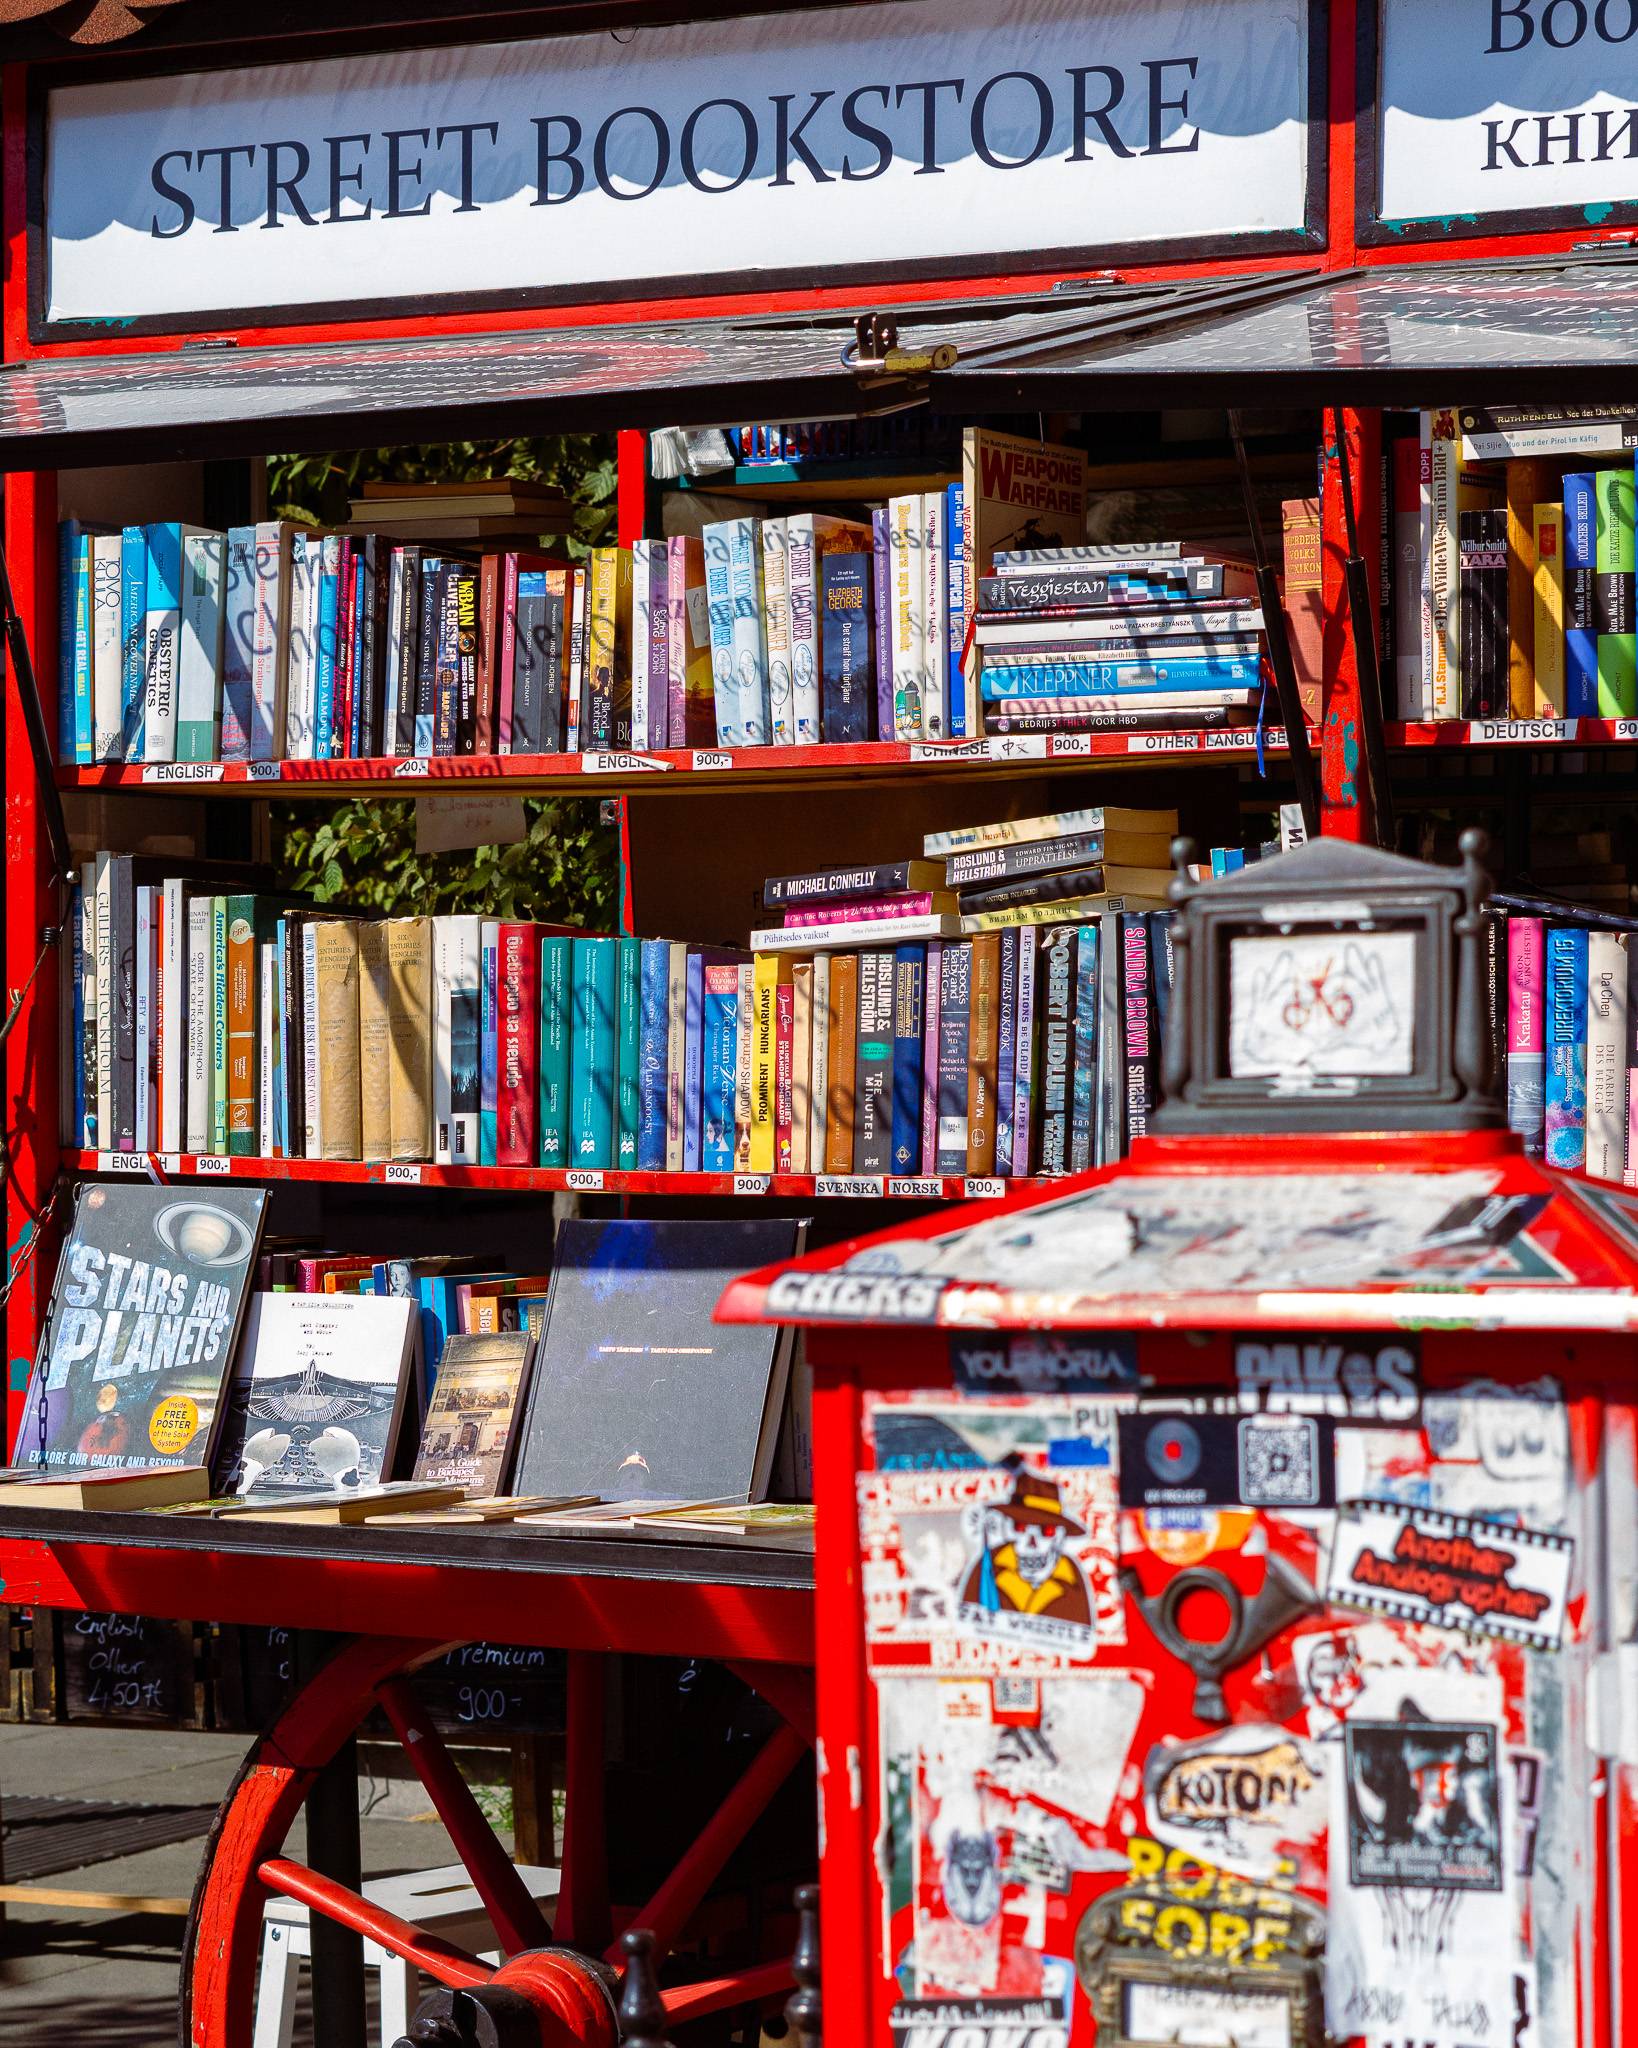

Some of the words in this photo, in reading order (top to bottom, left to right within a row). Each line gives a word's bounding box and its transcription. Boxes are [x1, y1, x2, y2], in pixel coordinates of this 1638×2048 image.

[149, 120, 500, 240] STREET
[530, 58, 1201, 206] BOOKSTORE
[1522, 413, 1562, 422] RENDELL
[1486, 442, 1501, 450] Sijie
[1551, 436, 1567, 444] Pirol
[1579, 435, 1598, 444] Käfig
[1420, 452, 1429, 480] TOPP
[1609, 479, 1619, 501] LUNTE
[1578, 491, 1588, 520] BEILEID
[1610, 503, 1620, 528] RIECHT
[898, 505, 910, 567] Bonniers
[963, 506, 971, 562] WEAPONS
[1285, 532, 1321, 547] HERDERS
[1461, 540, 1485, 551] Wilbur
[1486, 540, 1507, 551] Smith
[1578, 523, 1588, 561] TÖDLICHES
[1610, 529, 1620, 551] KATZE
[731, 535, 750, 566] DEBBIE
[790, 543, 810, 580] DEBBIE
[1288, 547, 1316, 560] VOLKS
[1461, 552, 1507, 566] TARA
[1610, 552, 1620, 564] DIE
[95, 559, 105, 611] KUULA
[106, 557, 120, 607] TOIVO
[447, 574, 459, 607] CLIVE
[595, 557, 612, 630] Josephine
[734, 570, 752, 620] MACOMBER
[828, 586, 863, 598] ELIZABETH
[897, 572, 909, 597] nya
[950, 560, 964, 607] American
[1609, 574, 1618, 597] BROWN
[76, 587, 85, 629] 30-MINUTE
[127, 565, 143, 635] AMERICAN
[256, 575, 267, 638] Sedimentology
[791, 584, 812, 642] MACOMBER
[828, 597, 862, 610] GEORGE
[1609, 599, 1618, 615] MAE
[445, 610, 458, 662] CUSSLER
[843, 623, 851, 636] Det
[899, 601, 912, 652] kokbok
[950, 612, 964, 652] Keiretsu
[1609, 617, 1618, 633] RITA
[76, 631, 86, 649] GET
[257, 640, 265, 655] and
[571, 622, 582, 664] BERLIN
[597, 630, 611, 657] Cox
[843, 638, 851, 656] straff
[76, 650, 86, 672] REAL
[147, 629, 158, 707] GENETICS
[158, 628, 172, 717] OBSTETRIC
[321, 655, 329, 687] DAVID
[843, 659, 851, 671] hon
[77, 673, 86, 696] MEALS
[255, 658, 264, 709] Stratigraphy
[841, 674, 851, 703] förtjänar
[1021, 667, 1113, 694] KLEPPNER
[319, 692, 328, 739] ALMOND
[441, 691, 450, 739] MARAUDER
[592, 696, 602, 735] Brothers
[601, 702, 610, 729] Blood
[1019, 718, 1087, 729] BEDRIJFSETHIEK
[1091, 717, 1116, 726] VOOR
[1119, 716, 1138, 725] HBO
[1054, 738, 1088, 752] 900,-
[1145, 736, 1194, 749] OTHER
[1484, 723, 1566, 739] DEUTSCH
[696, 754, 729, 766] 900,-
[1002, 738, 1029, 755] 中文
[157, 766, 213, 779] ENGLISH
[250, 765, 280, 776] 900,-
[953, 852, 996, 869] ROSLUND
[998, 850, 1006, 861] &
[1015, 849, 1078, 868] UPPRÄTTELSE
[787, 877, 827, 896] MICHAEL
[829, 871, 876, 890] CONNELLY
[953, 863, 1007, 883] HELLSTRÖM
[97, 892, 110, 966] GULLERS
[215, 910, 225, 970] America's
[763, 932, 802, 944] Pühitsedes
[803, 930, 830, 941] vaikust
[1023, 935, 1031, 953] LET
[1555, 939, 1575, 953] 15
[941, 949, 949, 977] Child
[949, 949, 959, 977] Baby
[1003, 936, 1013, 1000] BONNIERS
[1124, 928, 1147, 993] SANDRA
[744, 969, 755, 1014] michael
[861, 954, 876, 1033] HELLSTRÖM
[877, 954, 893, 1017] ROSLUND
[941, 980, 949, 1006] Care
[950, 978, 959, 999] and
[1601, 972, 1613, 987] Da
[215, 972, 225, 1018] Hidden
[1022, 975, 1030, 1023] NATIONS
[1554, 956, 1575, 1042] DIREKTORIUM
[1601, 990, 1613, 1017] Chen
[759, 988, 770, 1054] HUNGARIANS
[877, 1019, 890, 1031] &
[1000, 1002, 1011, 1051] KOKBOK
[1021, 1027, 1027, 1037] BE
[1127, 997, 1148, 1057] BROWN
[1516, 991, 1531, 1047] Krakatau
[99, 978, 111, 1095] STOCKHOLM
[215, 1020, 224, 1071] Corners
[740, 1016, 753, 1069] morpurgo
[1020, 1041, 1029, 1074] GLAD!
[1045, 1022, 1068, 1111] LUDLUM
[1596, 1045, 1604, 1064] DES
[1605, 1045, 1615, 1064] DIE
[740, 1071, 750, 1118] SHADOW
[759, 1063, 768, 1122] PROMINENT
[874, 1072, 883, 1095] TRE
[1595, 1069, 1604, 1114] BERGES
[1605, 1069, 1615, 1114] FARBEN
[864, 1077, 874, 1140] MINUTER
[1018, 1102, 1026, 1139] PIPER
[200, 1159, 228, 1171] 900,-
[388, 1166, 418, 1179] 900,-
[570, 1173, 600, 1186] 900,-
[817, 1181, 880, 1194] SVENSKA
[892, 1182, 939, 1194] NORSK
[968, 1181, 1001, 1193] 900,-
[64, 1245, 189, 1316] STARS
[190, 1279, 230, 1319] AND
[45, 1306, 224, 1391] PLANETS
[156, 1420, 191, 1429] POSTER
[164, 1411, 187, 1419] FREE
